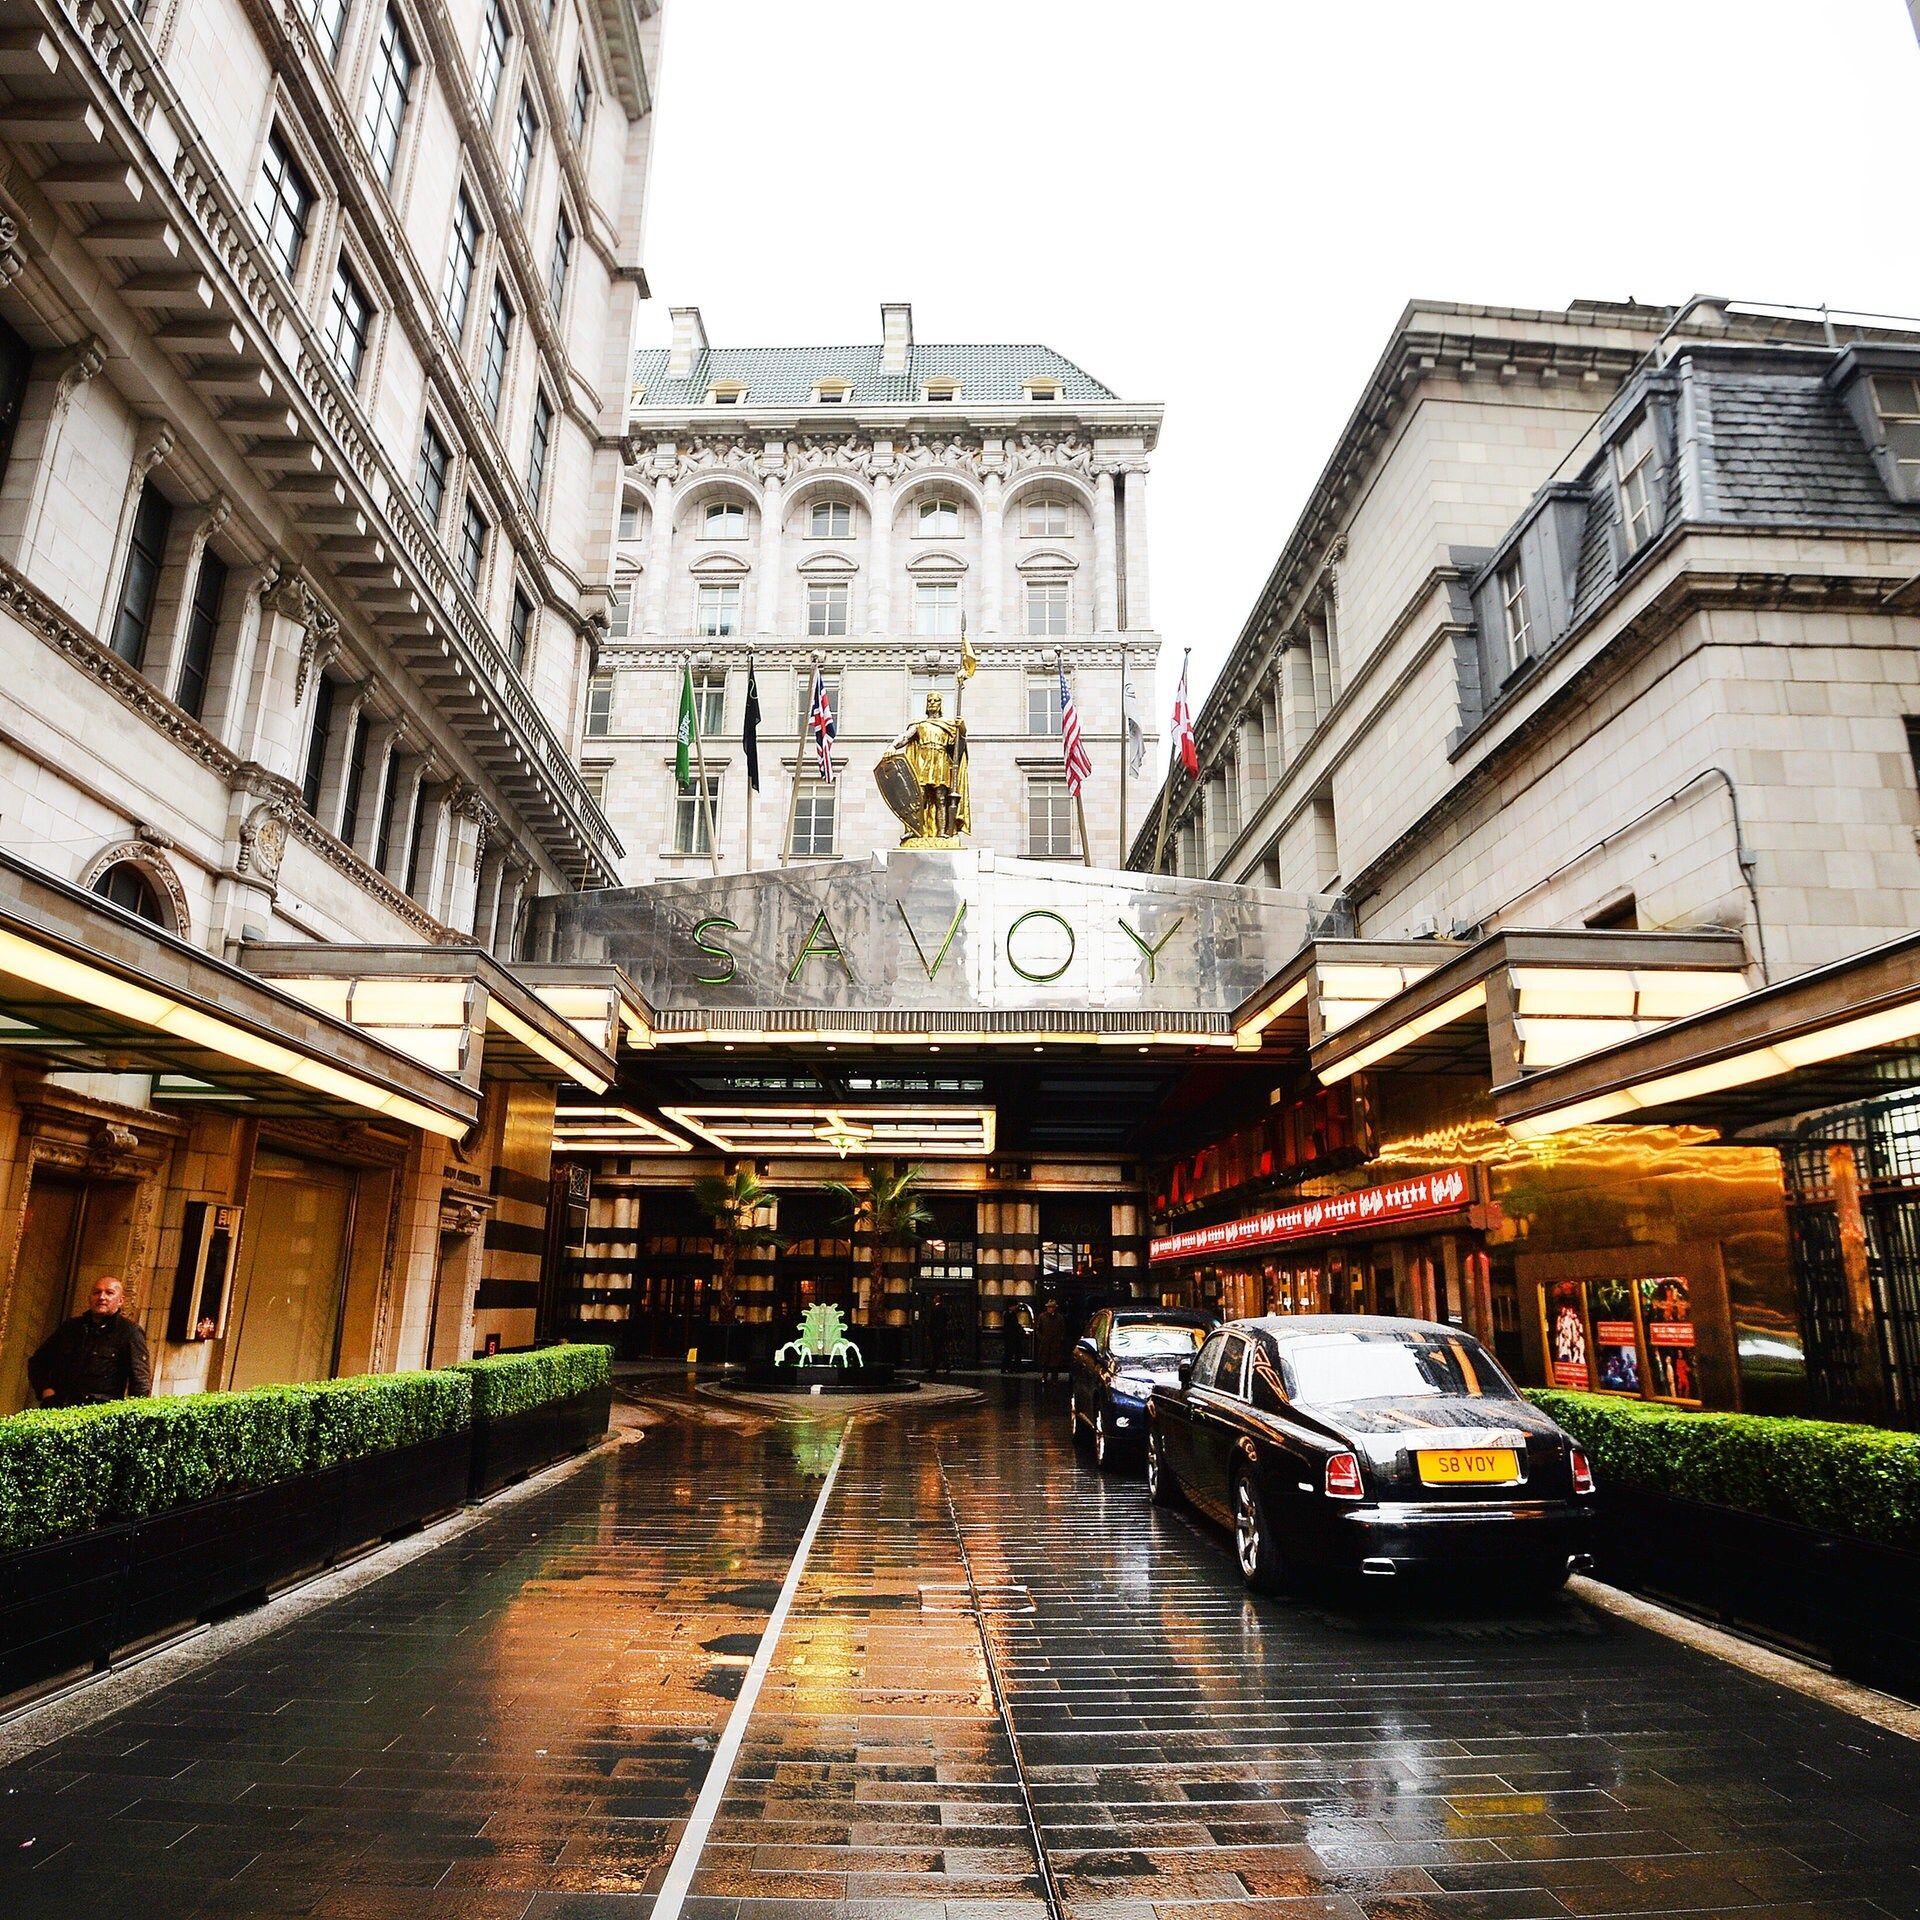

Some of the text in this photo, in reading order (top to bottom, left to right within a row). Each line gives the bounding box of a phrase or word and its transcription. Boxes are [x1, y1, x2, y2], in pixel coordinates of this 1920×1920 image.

[692, 899, 1183, 983] SAVOY
[1438, 1456, 1496, 1473] S8 VOY
